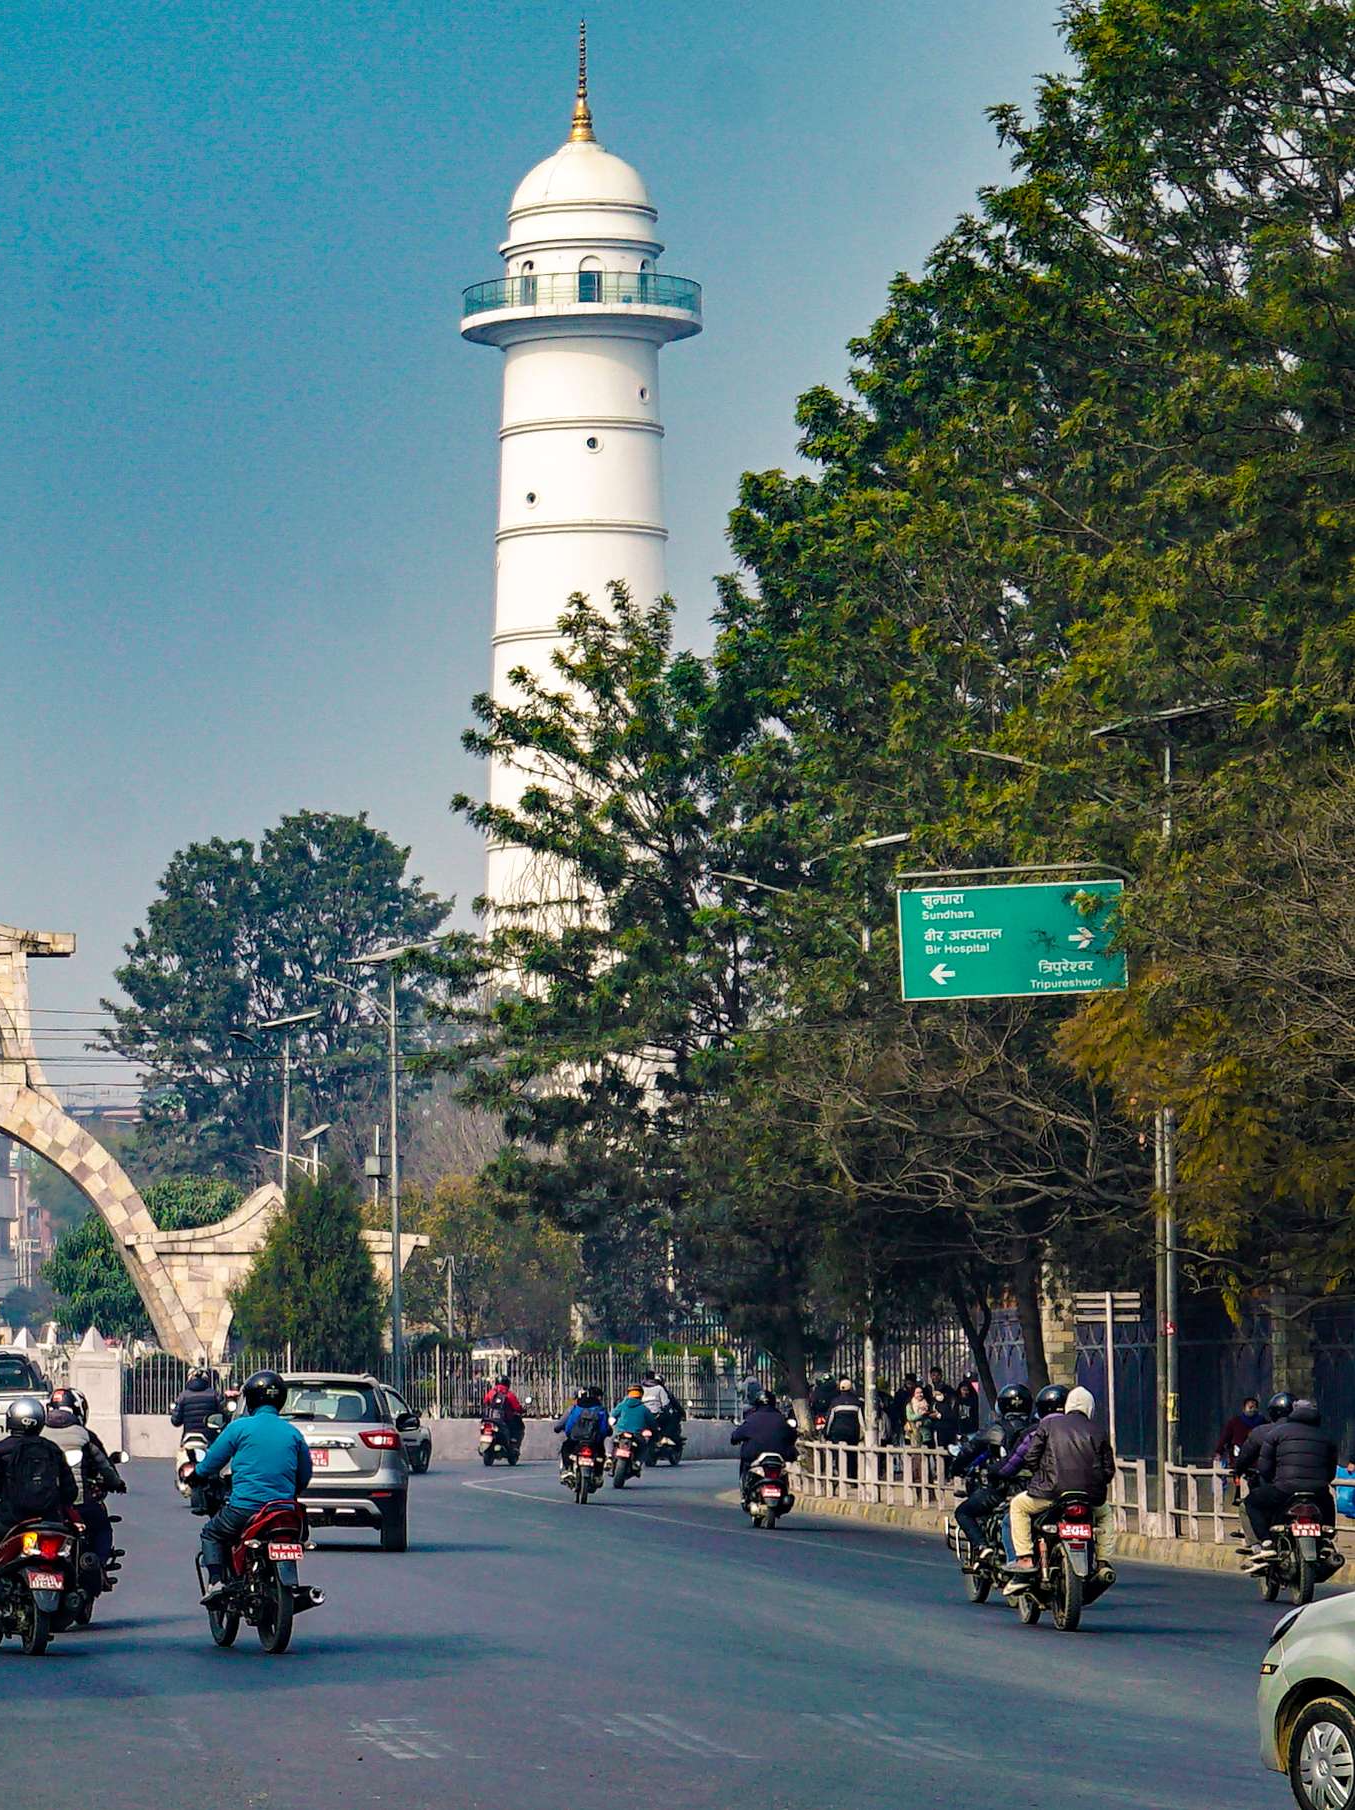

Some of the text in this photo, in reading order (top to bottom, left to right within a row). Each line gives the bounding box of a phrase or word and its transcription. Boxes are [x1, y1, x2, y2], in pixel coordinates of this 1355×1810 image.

[921, 894, 964, 908] सुन्धारा
[922, 910, 975, 920] Sundhara
[924, 928, 1002, 941] वीर अस्पताल
[925, 943, 990, 954] Bir Hospital
[1030, 978, 1102, 989] Tripureshwor
